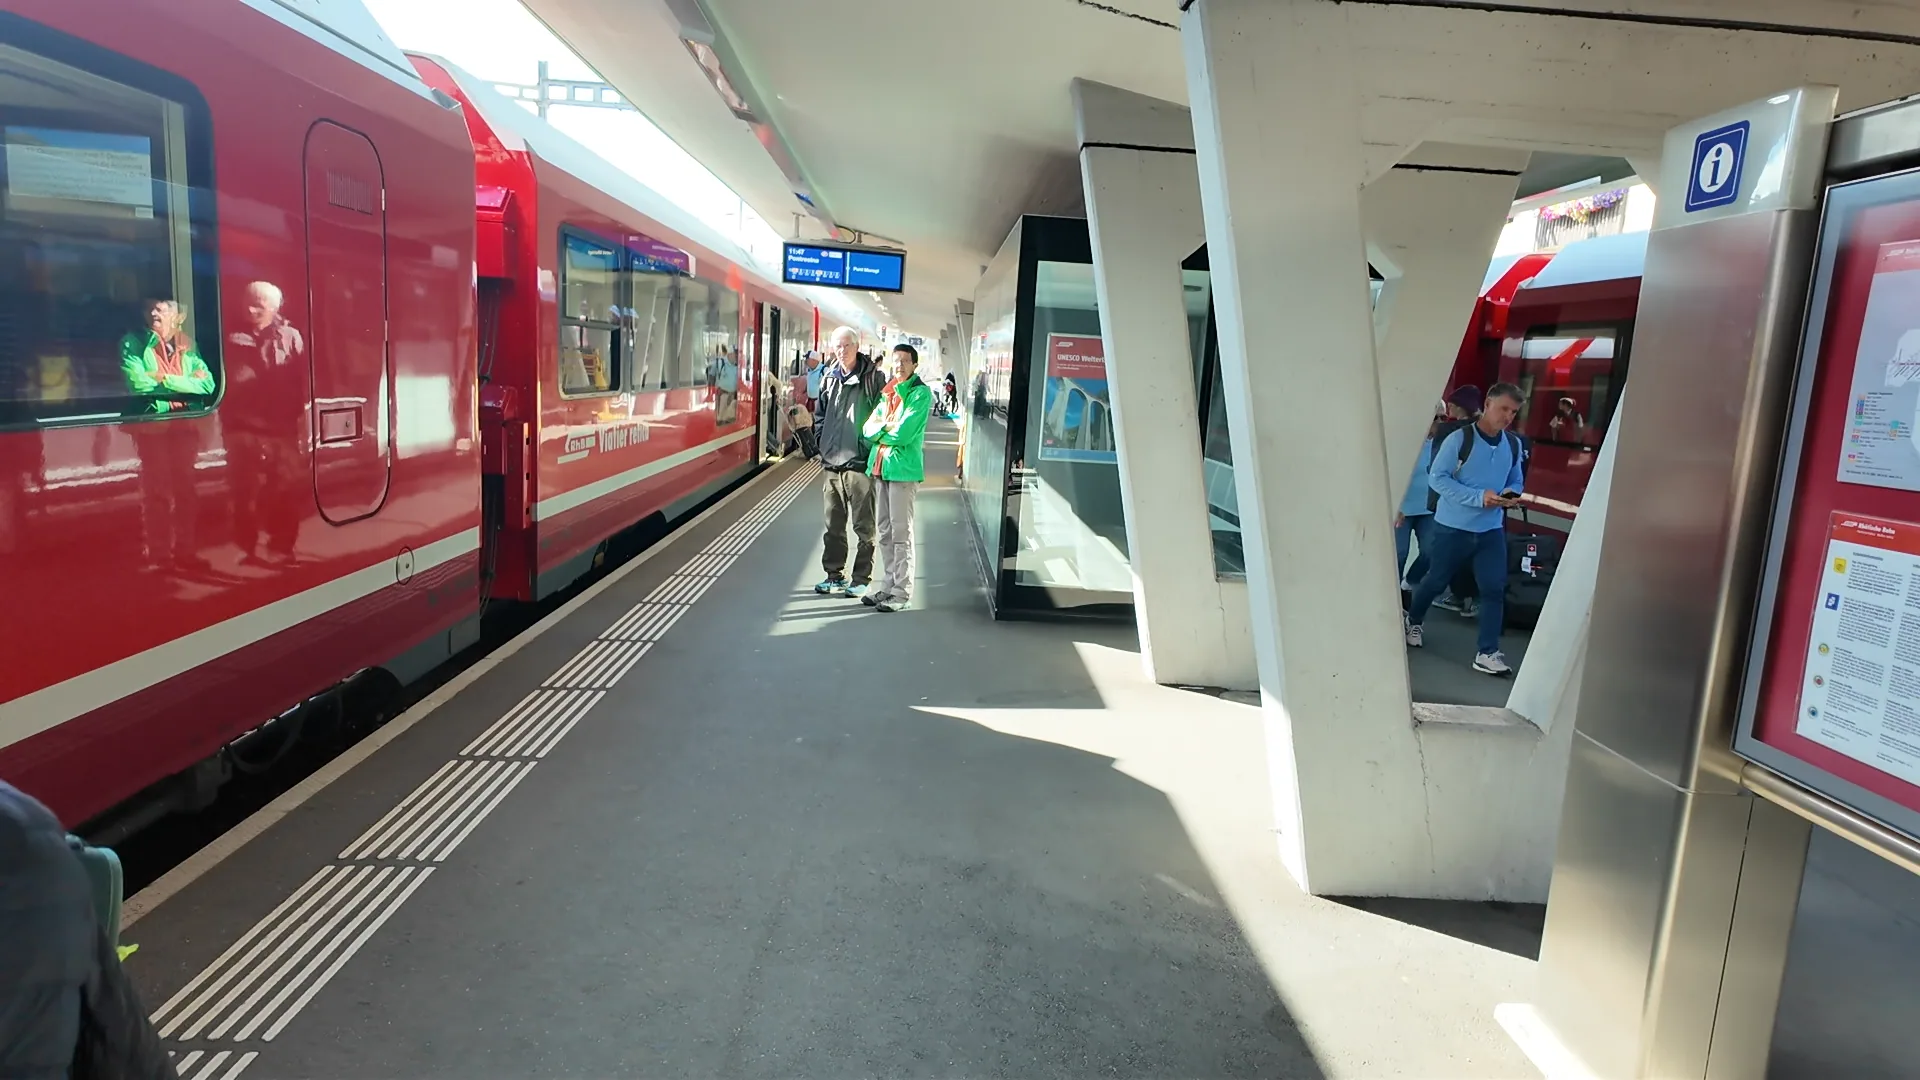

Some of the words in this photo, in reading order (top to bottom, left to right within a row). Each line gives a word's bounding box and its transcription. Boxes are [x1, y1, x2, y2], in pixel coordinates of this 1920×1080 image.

[1707, 146, 1723, 188] i
[788, 248, 805, 256] 11:47
[1057, 353, 1080, 362] UNESCO
